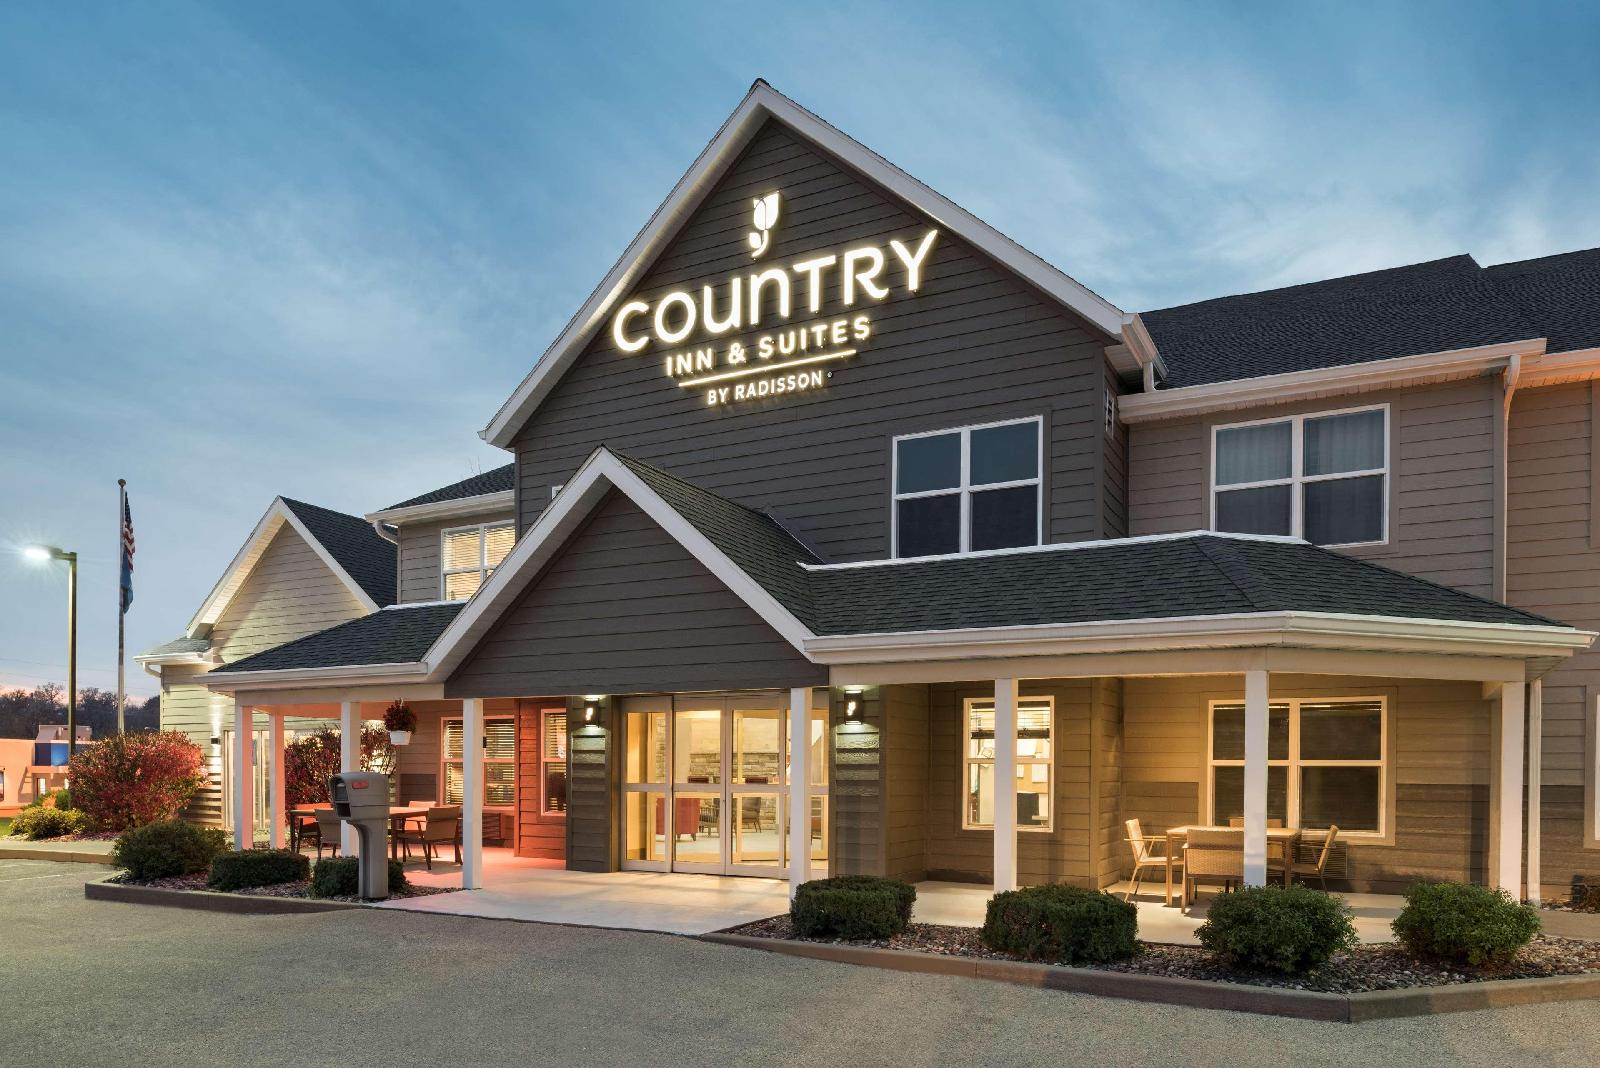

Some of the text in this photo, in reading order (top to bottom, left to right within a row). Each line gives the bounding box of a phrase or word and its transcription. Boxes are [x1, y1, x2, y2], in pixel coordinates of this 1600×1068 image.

[665, 316, 871, 377] INN & SUITES
[706, 370, 823, 406] BY RADISSON
